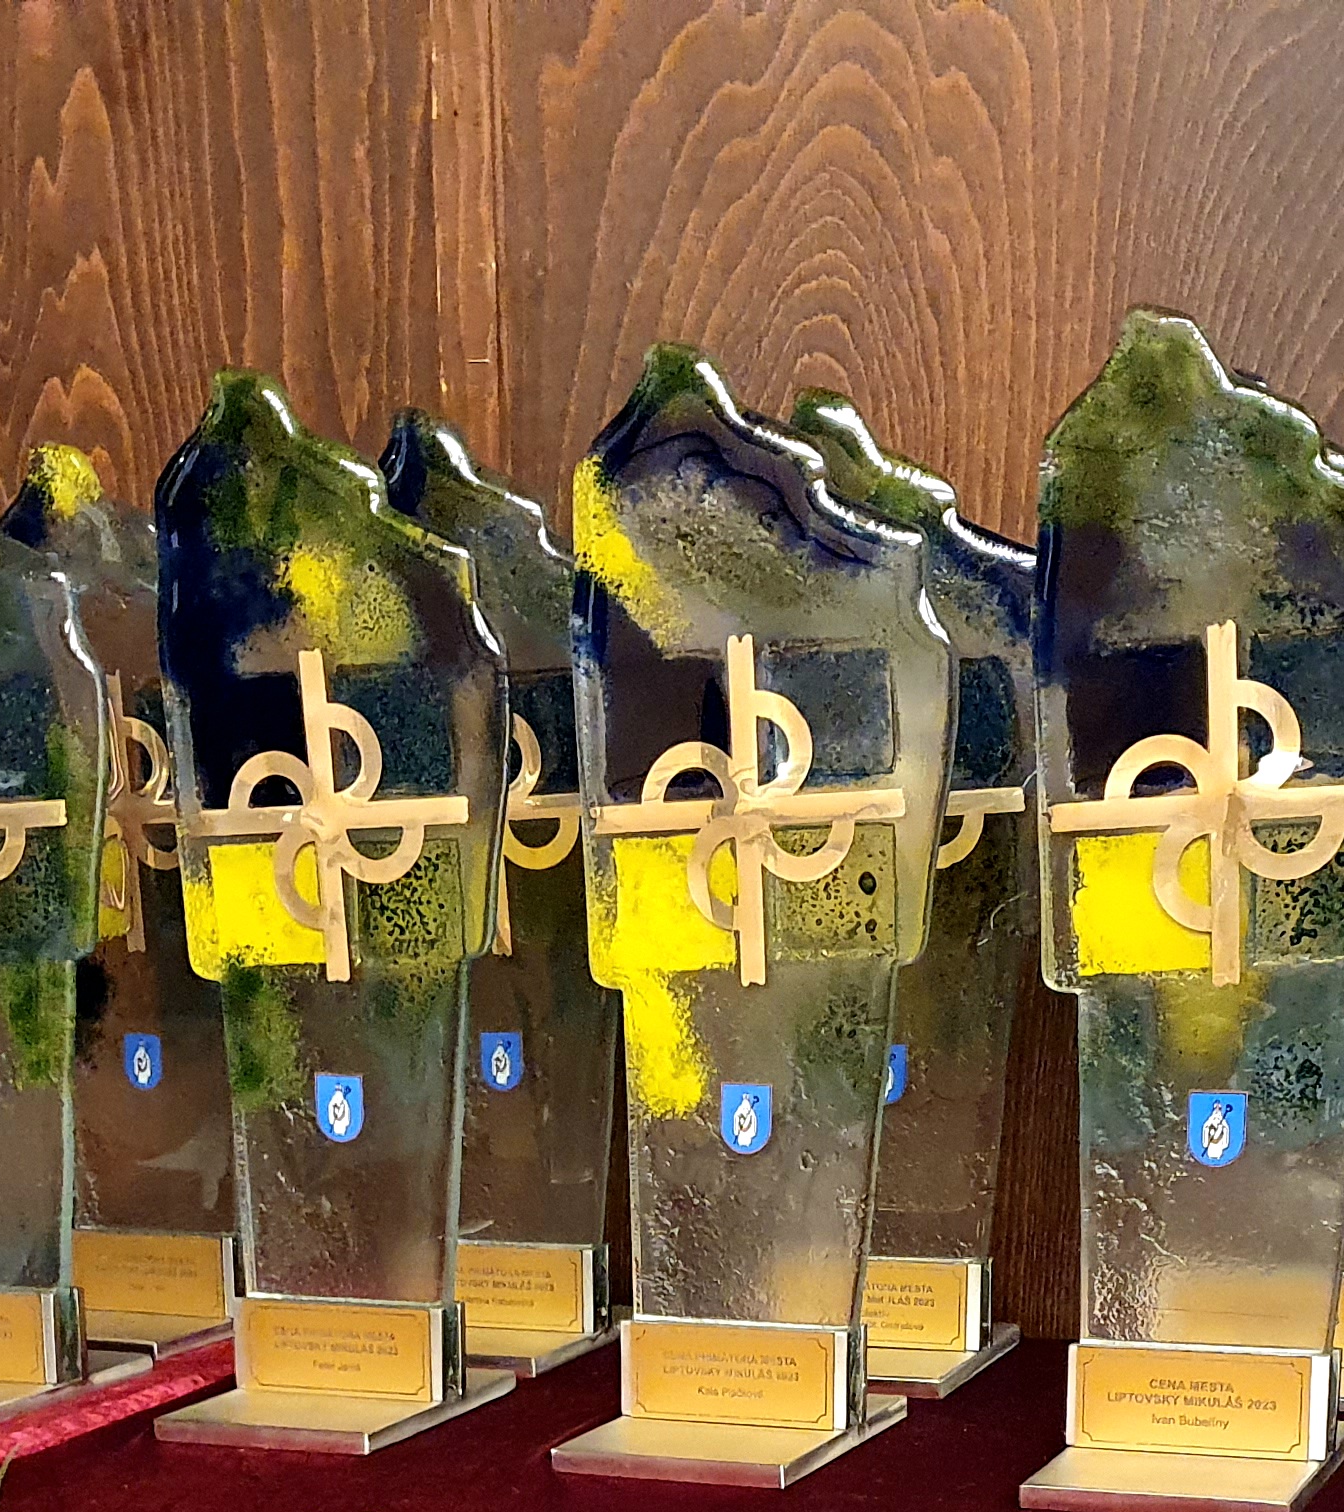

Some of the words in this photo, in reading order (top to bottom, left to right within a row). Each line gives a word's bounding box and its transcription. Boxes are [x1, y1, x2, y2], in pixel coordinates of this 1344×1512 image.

[1149, 1378, 1186, 1391] CENA
[1189, 1380, 1235, 1393] MESTA
[1247, 1398, 1277, 1411] 2023
[1151, 1413, 1176, 1425] Ivan
